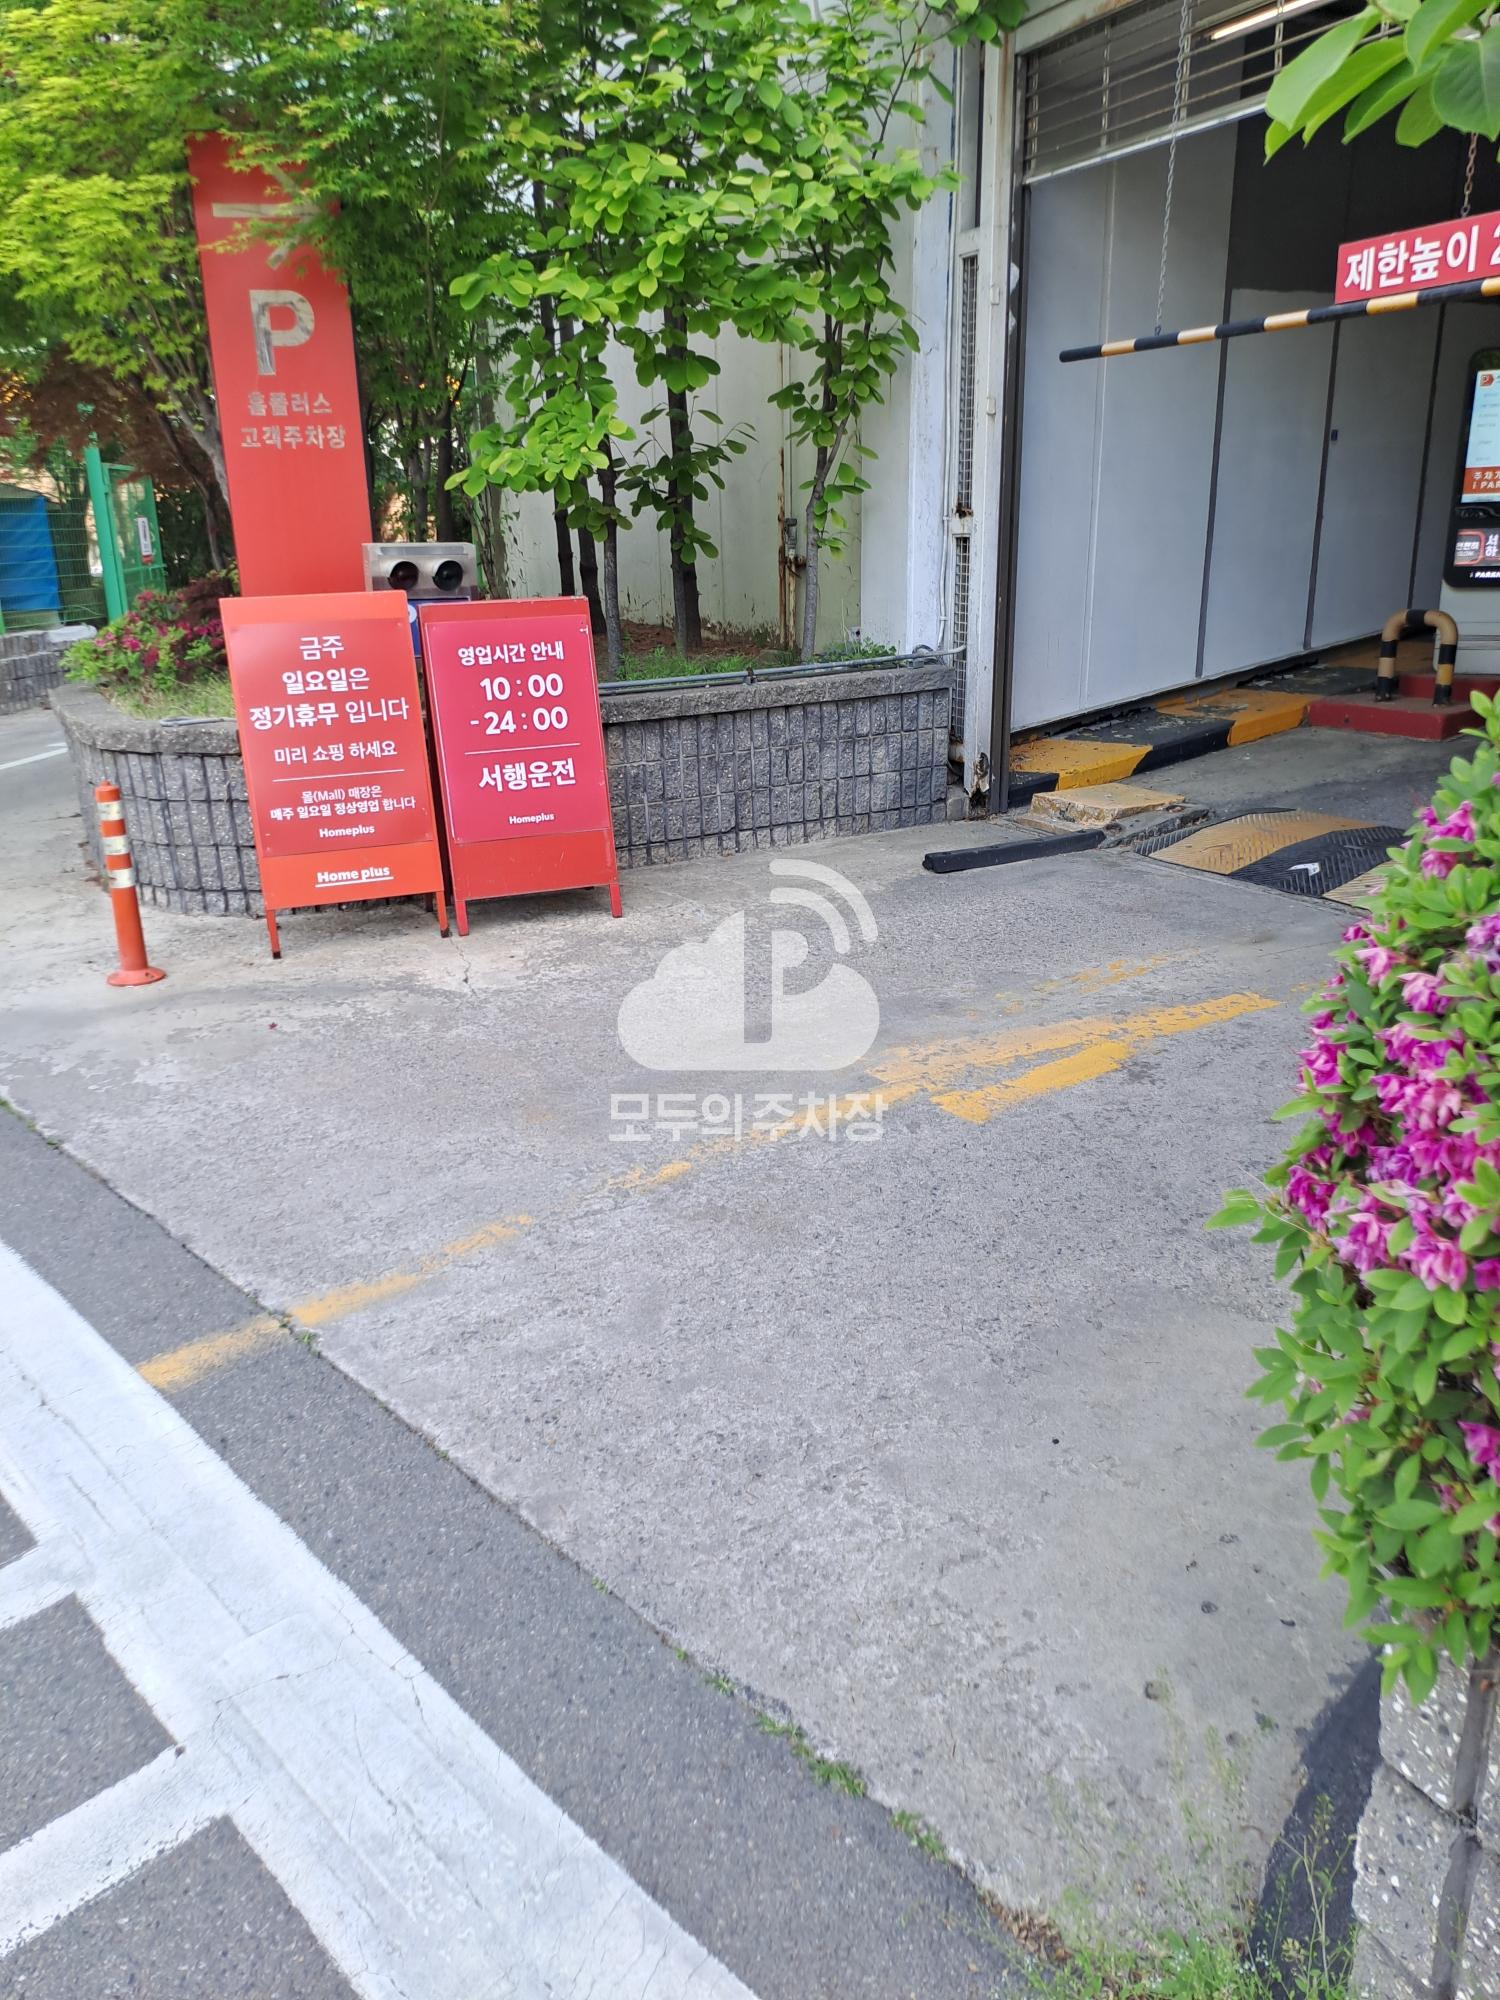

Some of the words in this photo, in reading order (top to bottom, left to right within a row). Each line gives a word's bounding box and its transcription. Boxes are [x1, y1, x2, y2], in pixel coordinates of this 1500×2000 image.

[1343, 225, 1480, 292] 제한높이
[249, 289, 315, 376] P
[247, 391, 333, 416] 홈플러스
[240, 424, 346, 450] 고객주차장
[299, 635, 345, 661] 금주
[458, 643, 526, 666] 영업시간
[531, 641, 565, 662] 안내
[282, 667, 370, 695] 일요일은
[479, 673, 564, 702] 10:00
[250, 702, 339, 731] 정기휴무
[345, 697, 409, 724] 입니다
[274, 747, 307, 765] 미리
[312, 743, 345, 762] 쇼핑
[348, 740, 398, 759] 하세요
[478, 757, 577, 793] 서행운전
[301, 788, 346, 804] 몰(Mall)
[348, 785, 383, 800] 매장은
[270, 807, 294, 821] 매주
[296, 804, 331, 819] 일요일
[334, 800, 380, 816] 정상영업
[382, 796, 416, 812] 합니다
[509, 812, 555, 825] Homeplus
[319, 824, 375, 838] Homeplus
